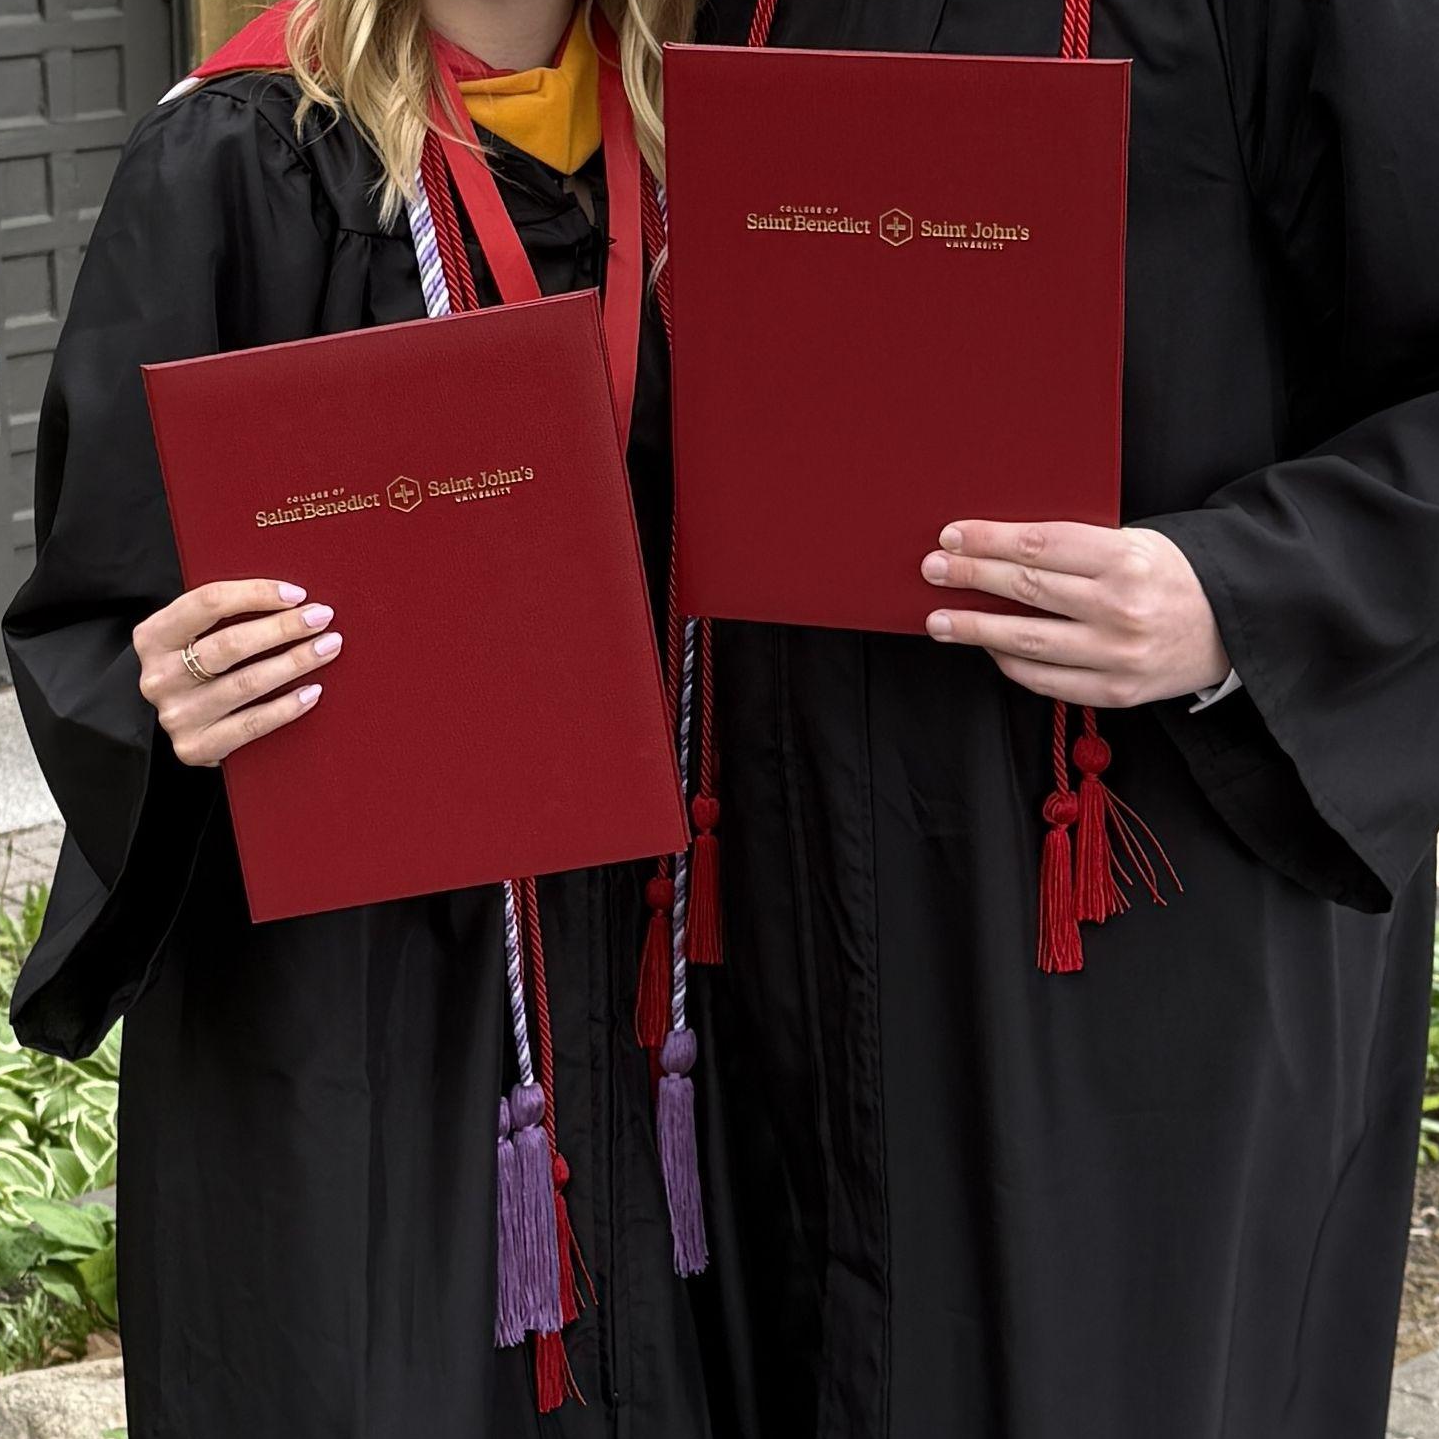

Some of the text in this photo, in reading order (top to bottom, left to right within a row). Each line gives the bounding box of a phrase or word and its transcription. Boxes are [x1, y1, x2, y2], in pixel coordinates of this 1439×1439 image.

[746, 212, 871, 234] Saint Benedict
[920, 220, 1030, 241] Saint John's
[428, 466, 534, 497] Saint John's
[255, 493, 381, 527] Saint Benedict
